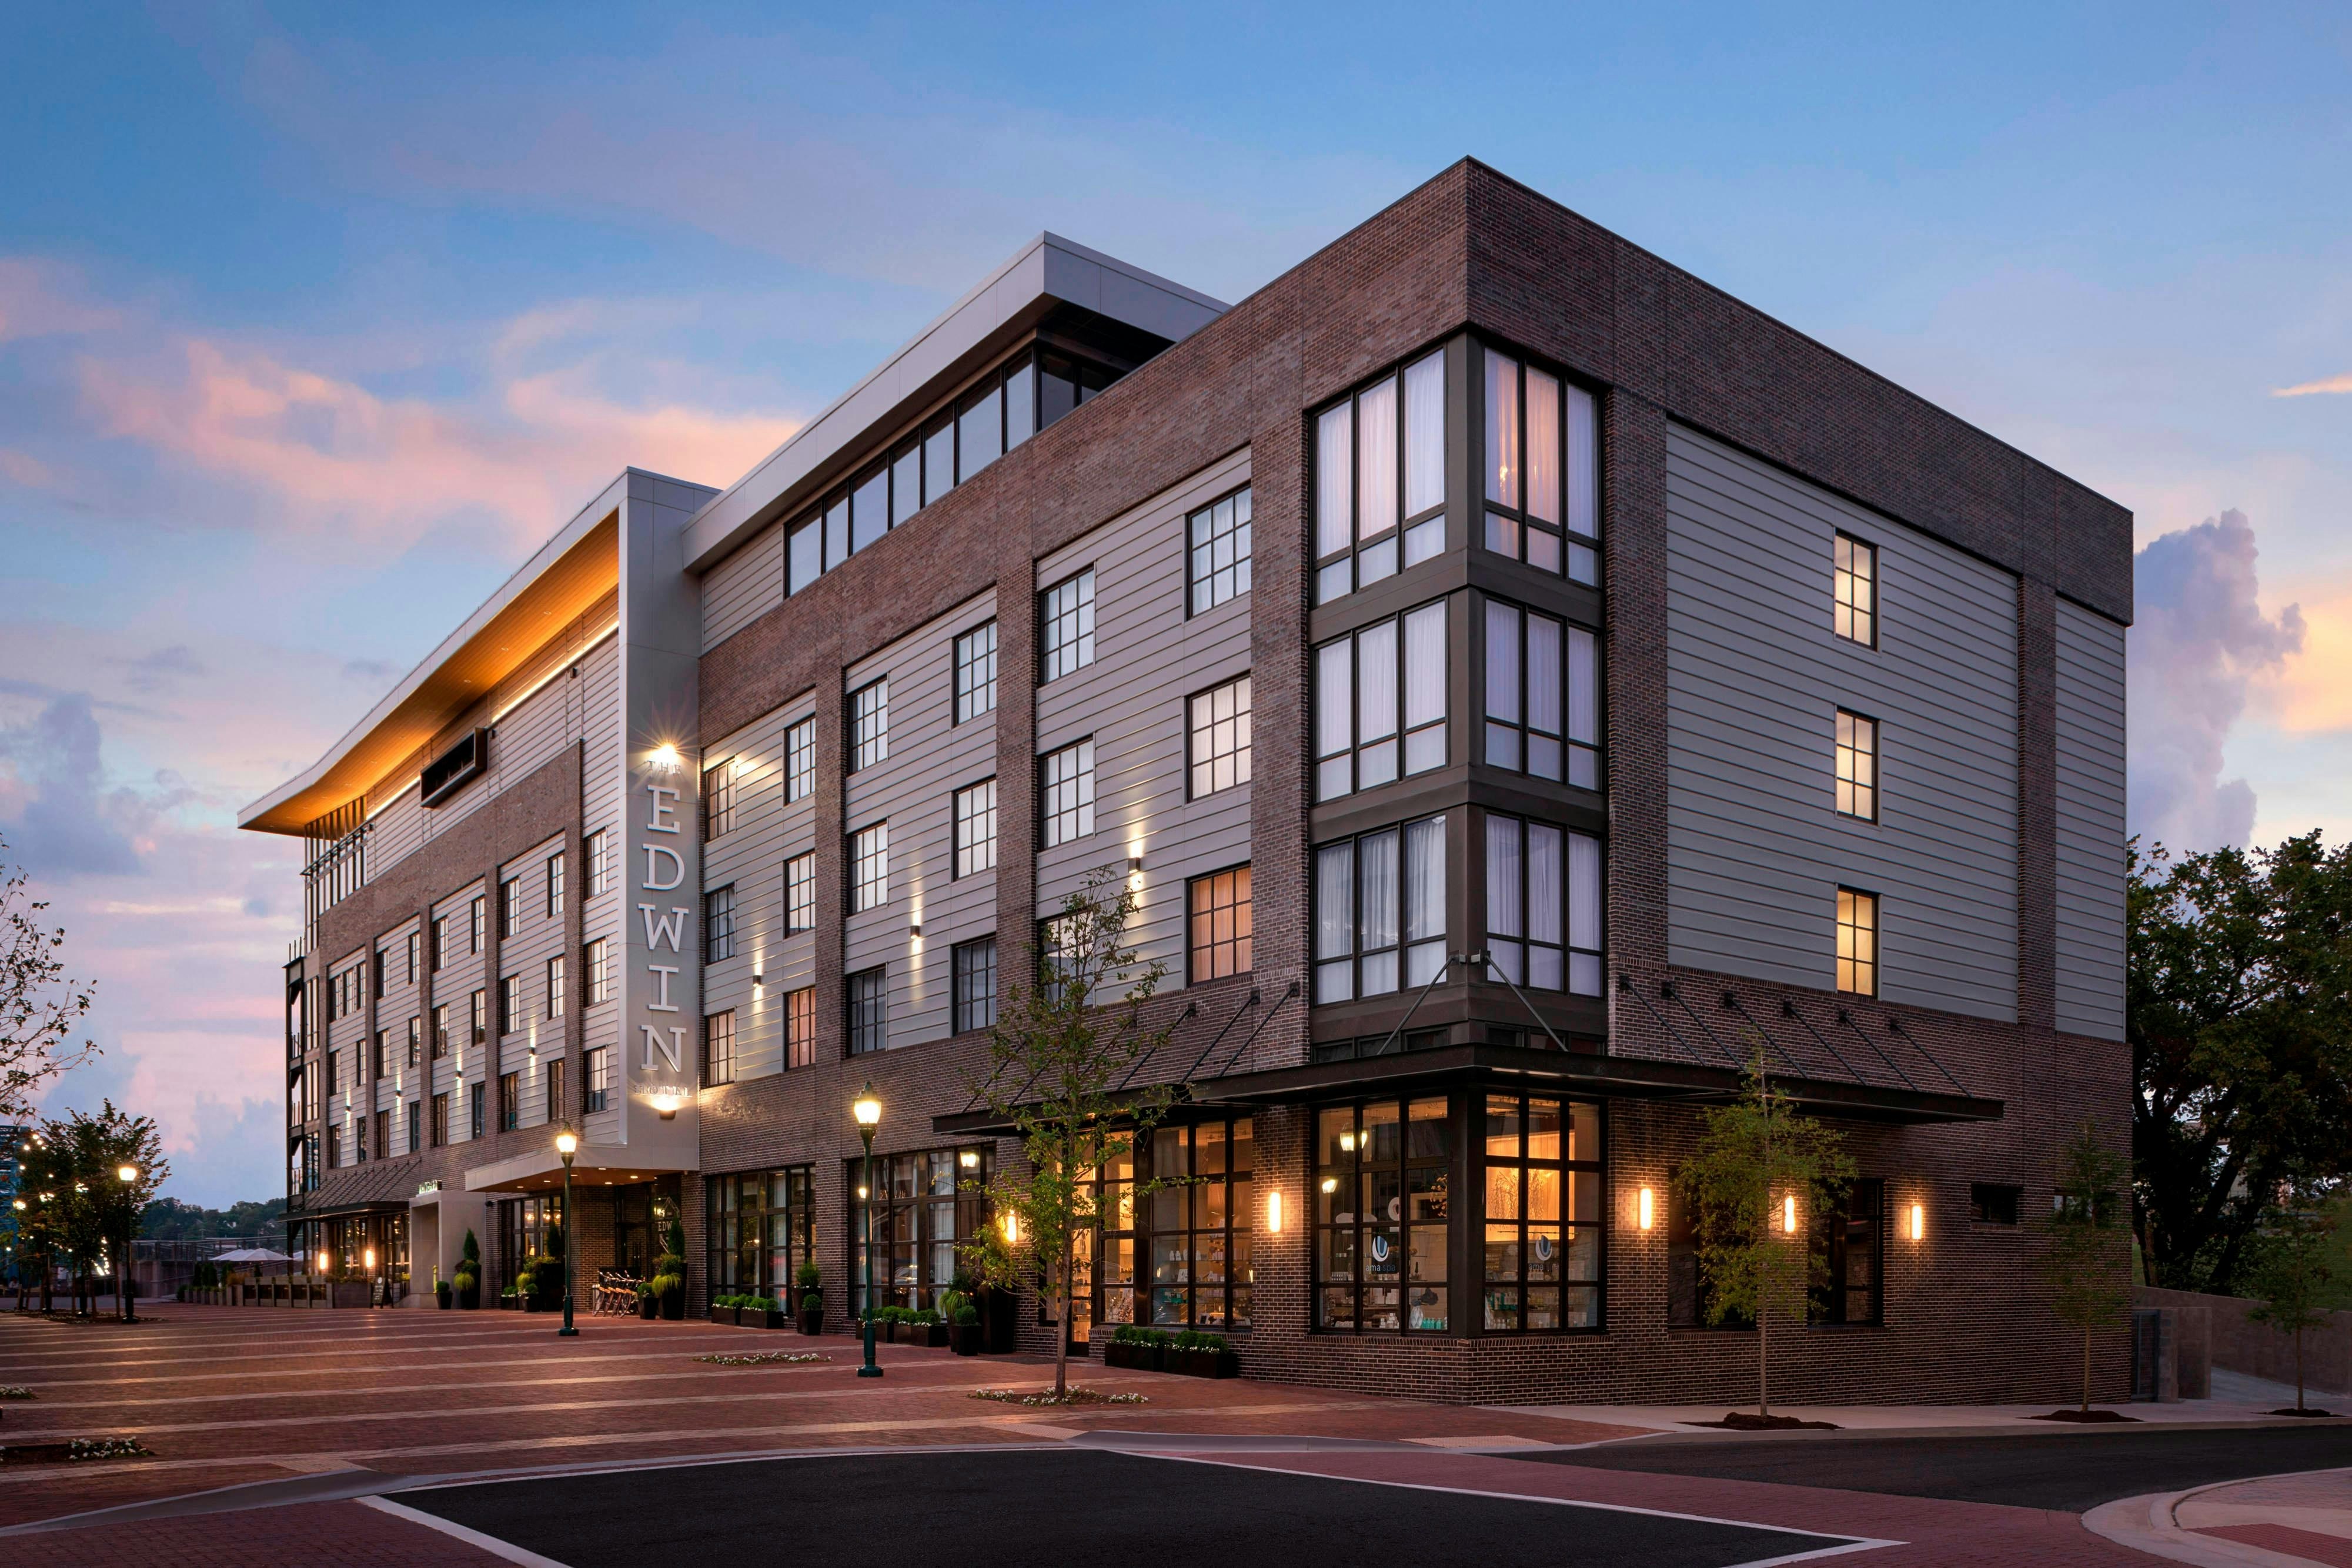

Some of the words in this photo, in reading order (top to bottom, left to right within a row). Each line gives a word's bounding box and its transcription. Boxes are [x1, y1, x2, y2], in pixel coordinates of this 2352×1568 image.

[644, 760, 681, 776] THE
[638, 785, 689, 1072] EDWIN
[658, 1220, 681, 1232] EDW
